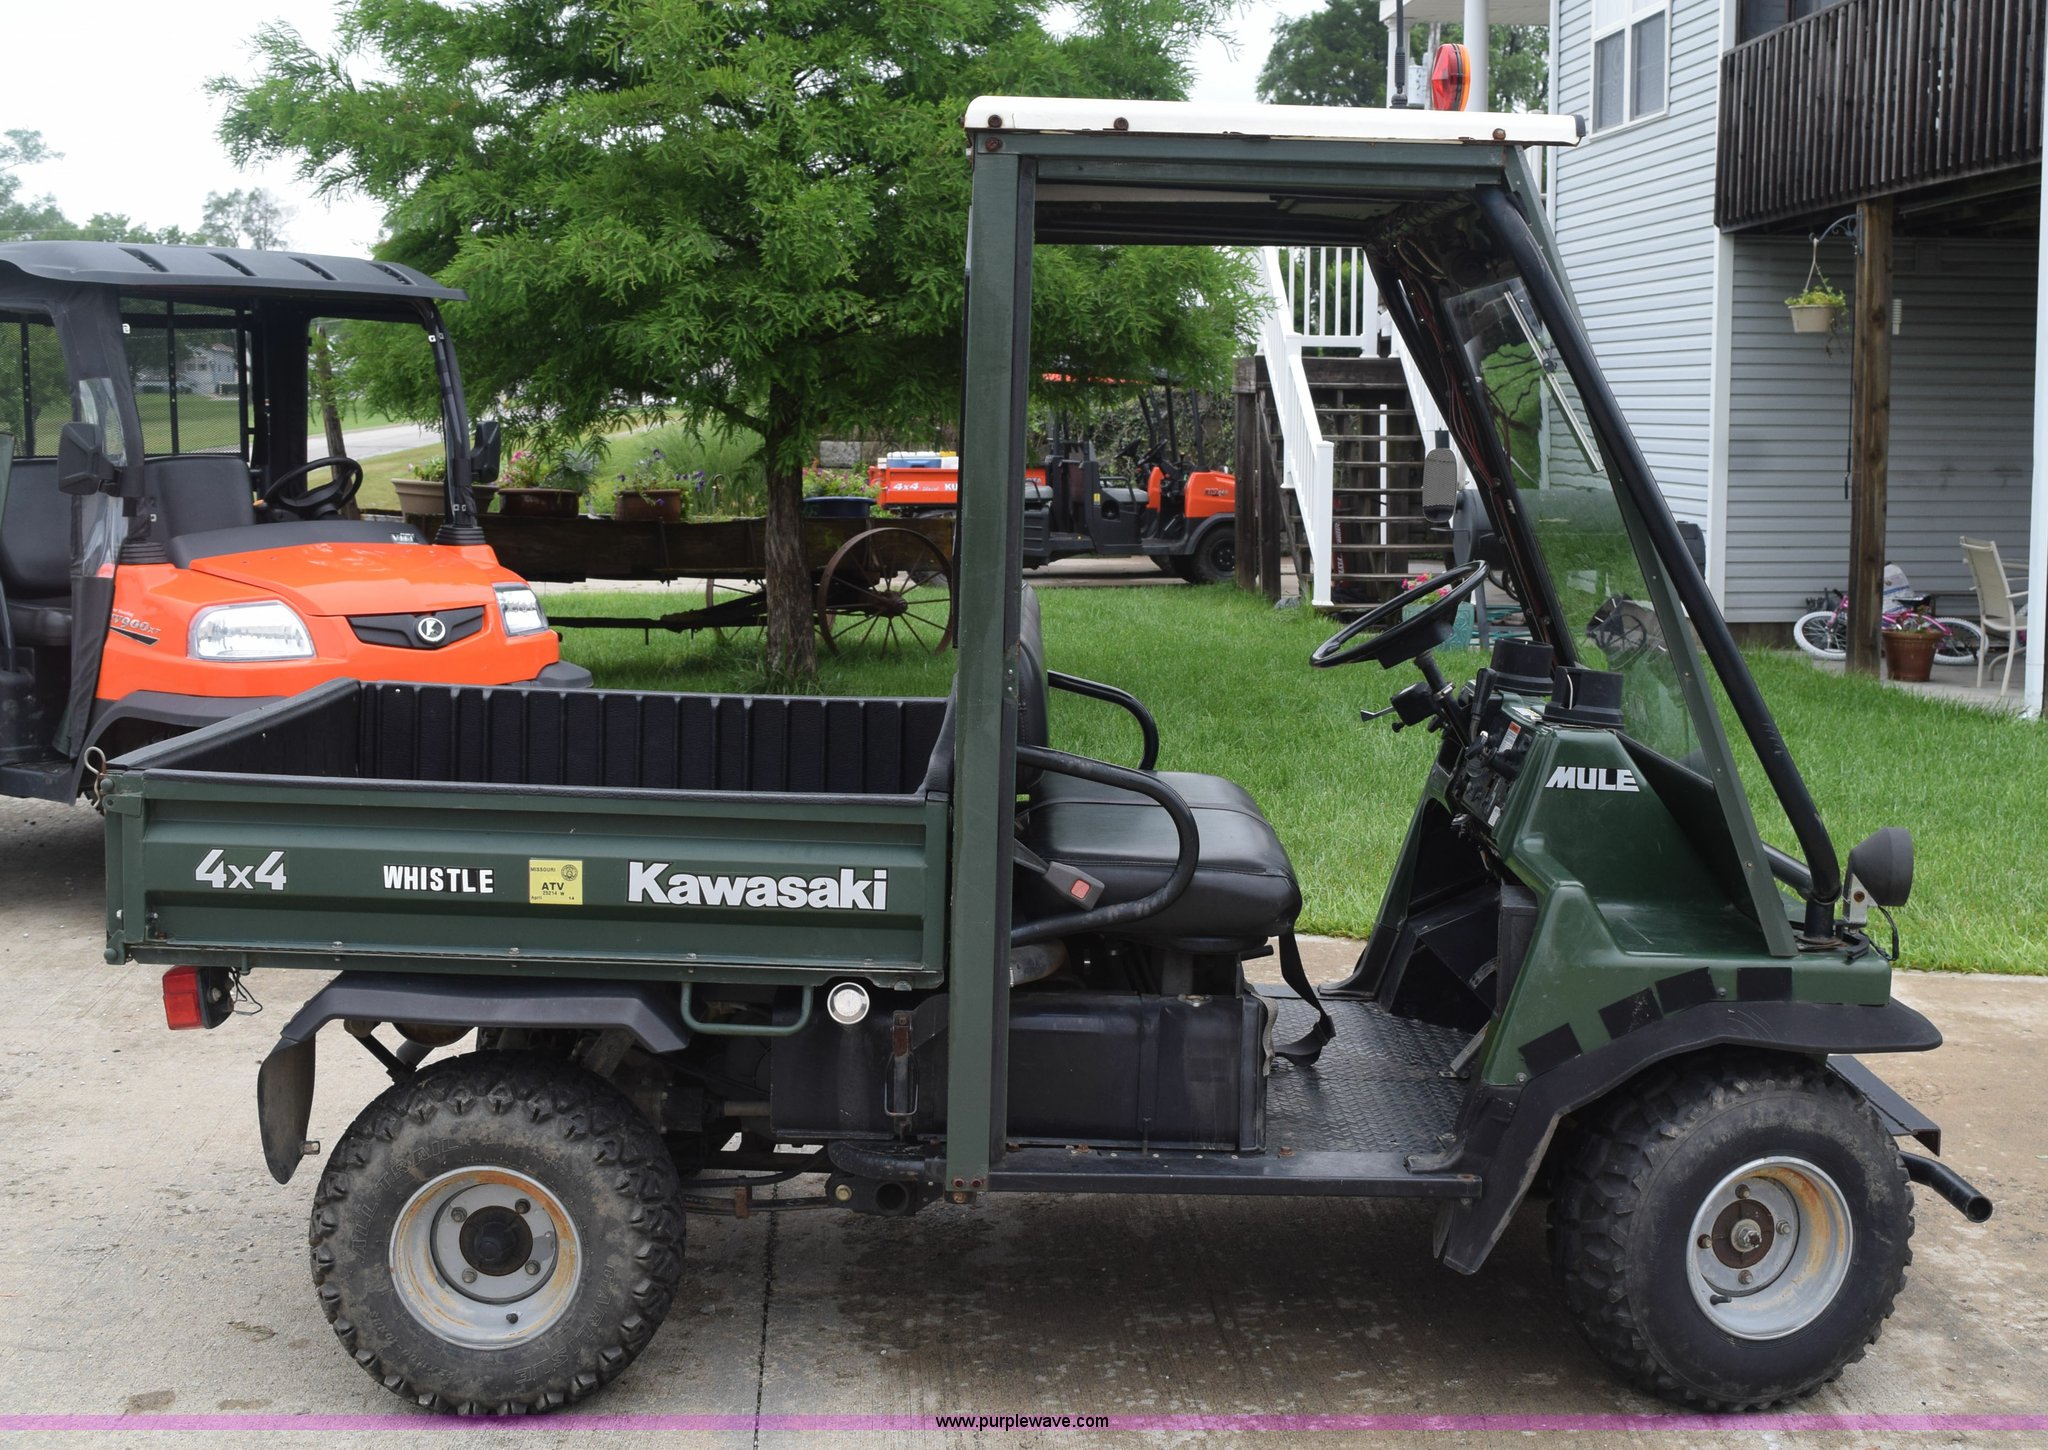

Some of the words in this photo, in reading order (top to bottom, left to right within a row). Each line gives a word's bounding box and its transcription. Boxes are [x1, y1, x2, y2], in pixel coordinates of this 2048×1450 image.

[893, 482, 919, 491] 4x4
[1544, 766, 1640, 792] MULE
[195, 849, 287, 891] 4x4
[383, 865, 494, 894] WHISTLE
[541, 882, 565, 891] ATV
[628, 861, 887, 911] Kawasaki
[352, 1203, 380, 1260] ALL
[513, 1263, 615, 1385] CARLISLE
